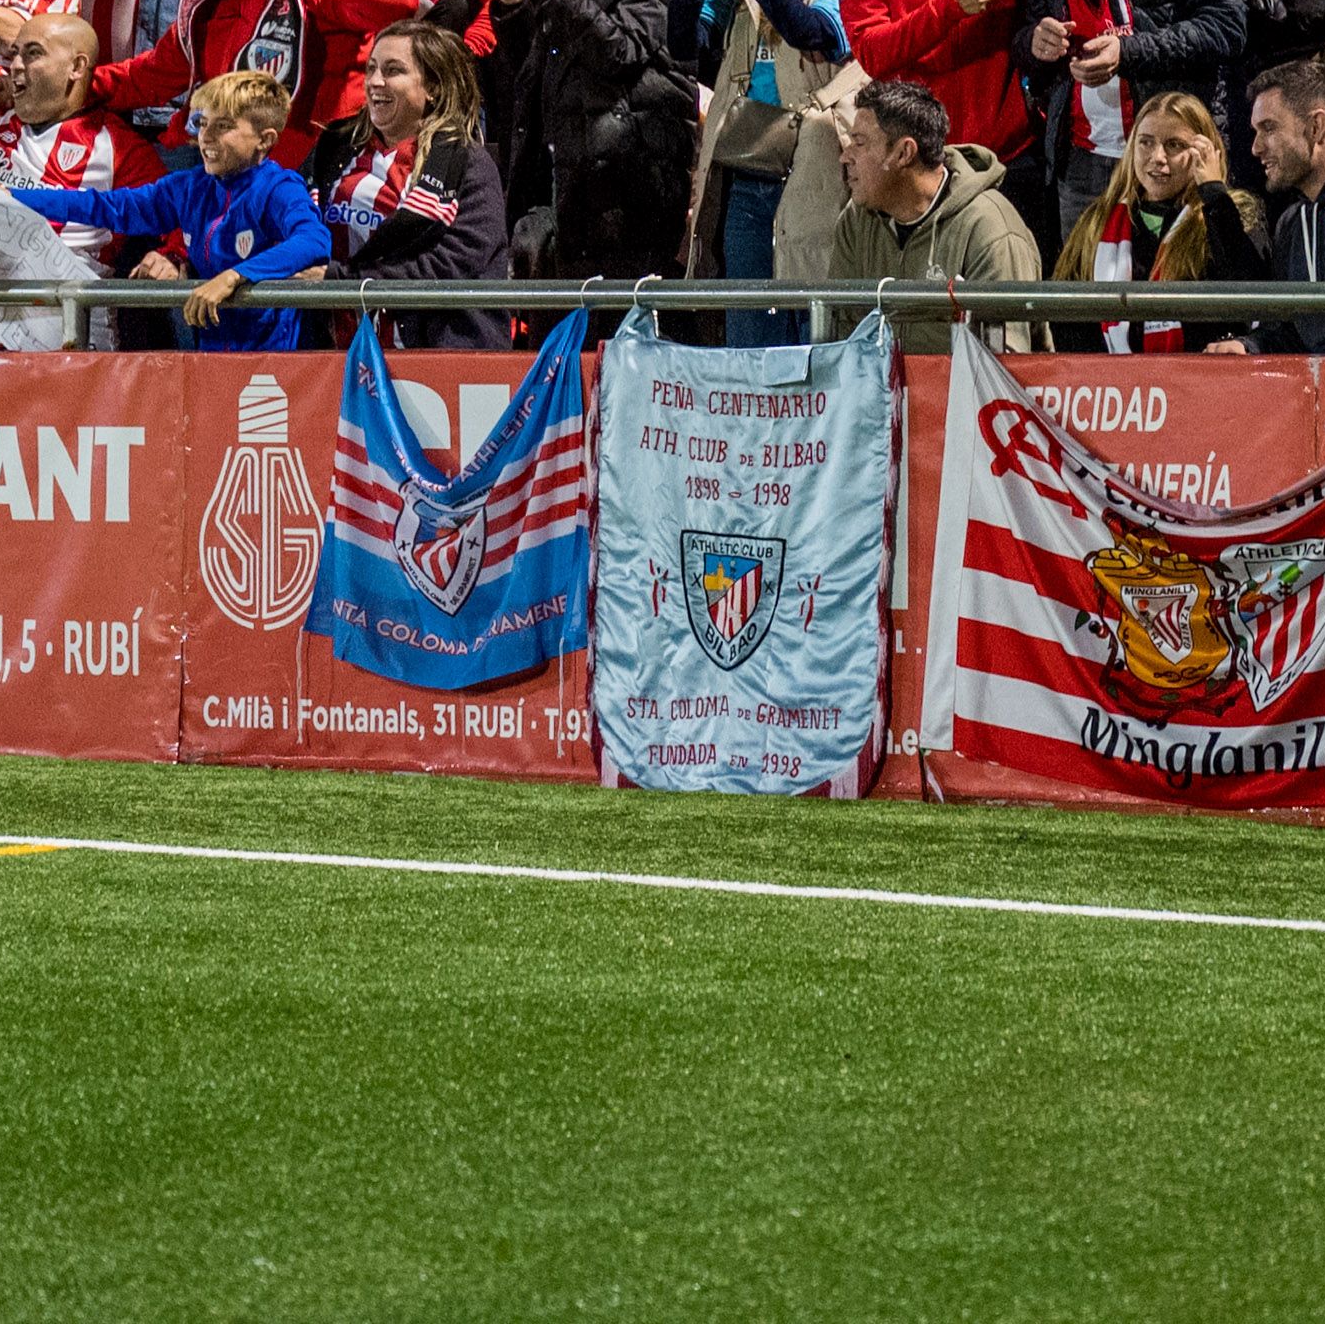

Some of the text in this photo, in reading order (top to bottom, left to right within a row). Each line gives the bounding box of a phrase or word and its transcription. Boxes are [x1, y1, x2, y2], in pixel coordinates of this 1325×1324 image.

[325, 201, 383, 227] etron
[652, 379, 827, 419] PEÑA CENTENARIO
[1032, 386, 1169, 433] TRICIDAD
[639, 426, 682, 458] ATH.
[688, 436, 728, 464] CLUB
[762, 441, 827, 467] BILBAO
[684, 476, 721, 501] 1898
[690, 538, 774, 558] ATHLETIC CLUB
[1124, 583, 1197, 597] MINGLANILLA
[19, 618, 38, 675] 5
[63, 606, 145, 676] RUBÍ
[331, 598, 369, 630] NTA
[376, 618, 469, 657] COLOMA
[484, 593, 568, 639] RAMENE
[703, 620, 759, 662] BILBAO
[202, 694, 275, 731] C.Milà
[281, 700, 290, 731] i
[299, 698, 426, 743] Fontanals,
[432, 704, 457, 737] 31
[464, 697, 525, 740] RUBÍ
[627, 696, 665, 720] STA.
[670, 694, 730, 721] COLOMA
[756, 702, 842, 732] GRAMENET
[647, 743, 718, 766] FUNDADA
